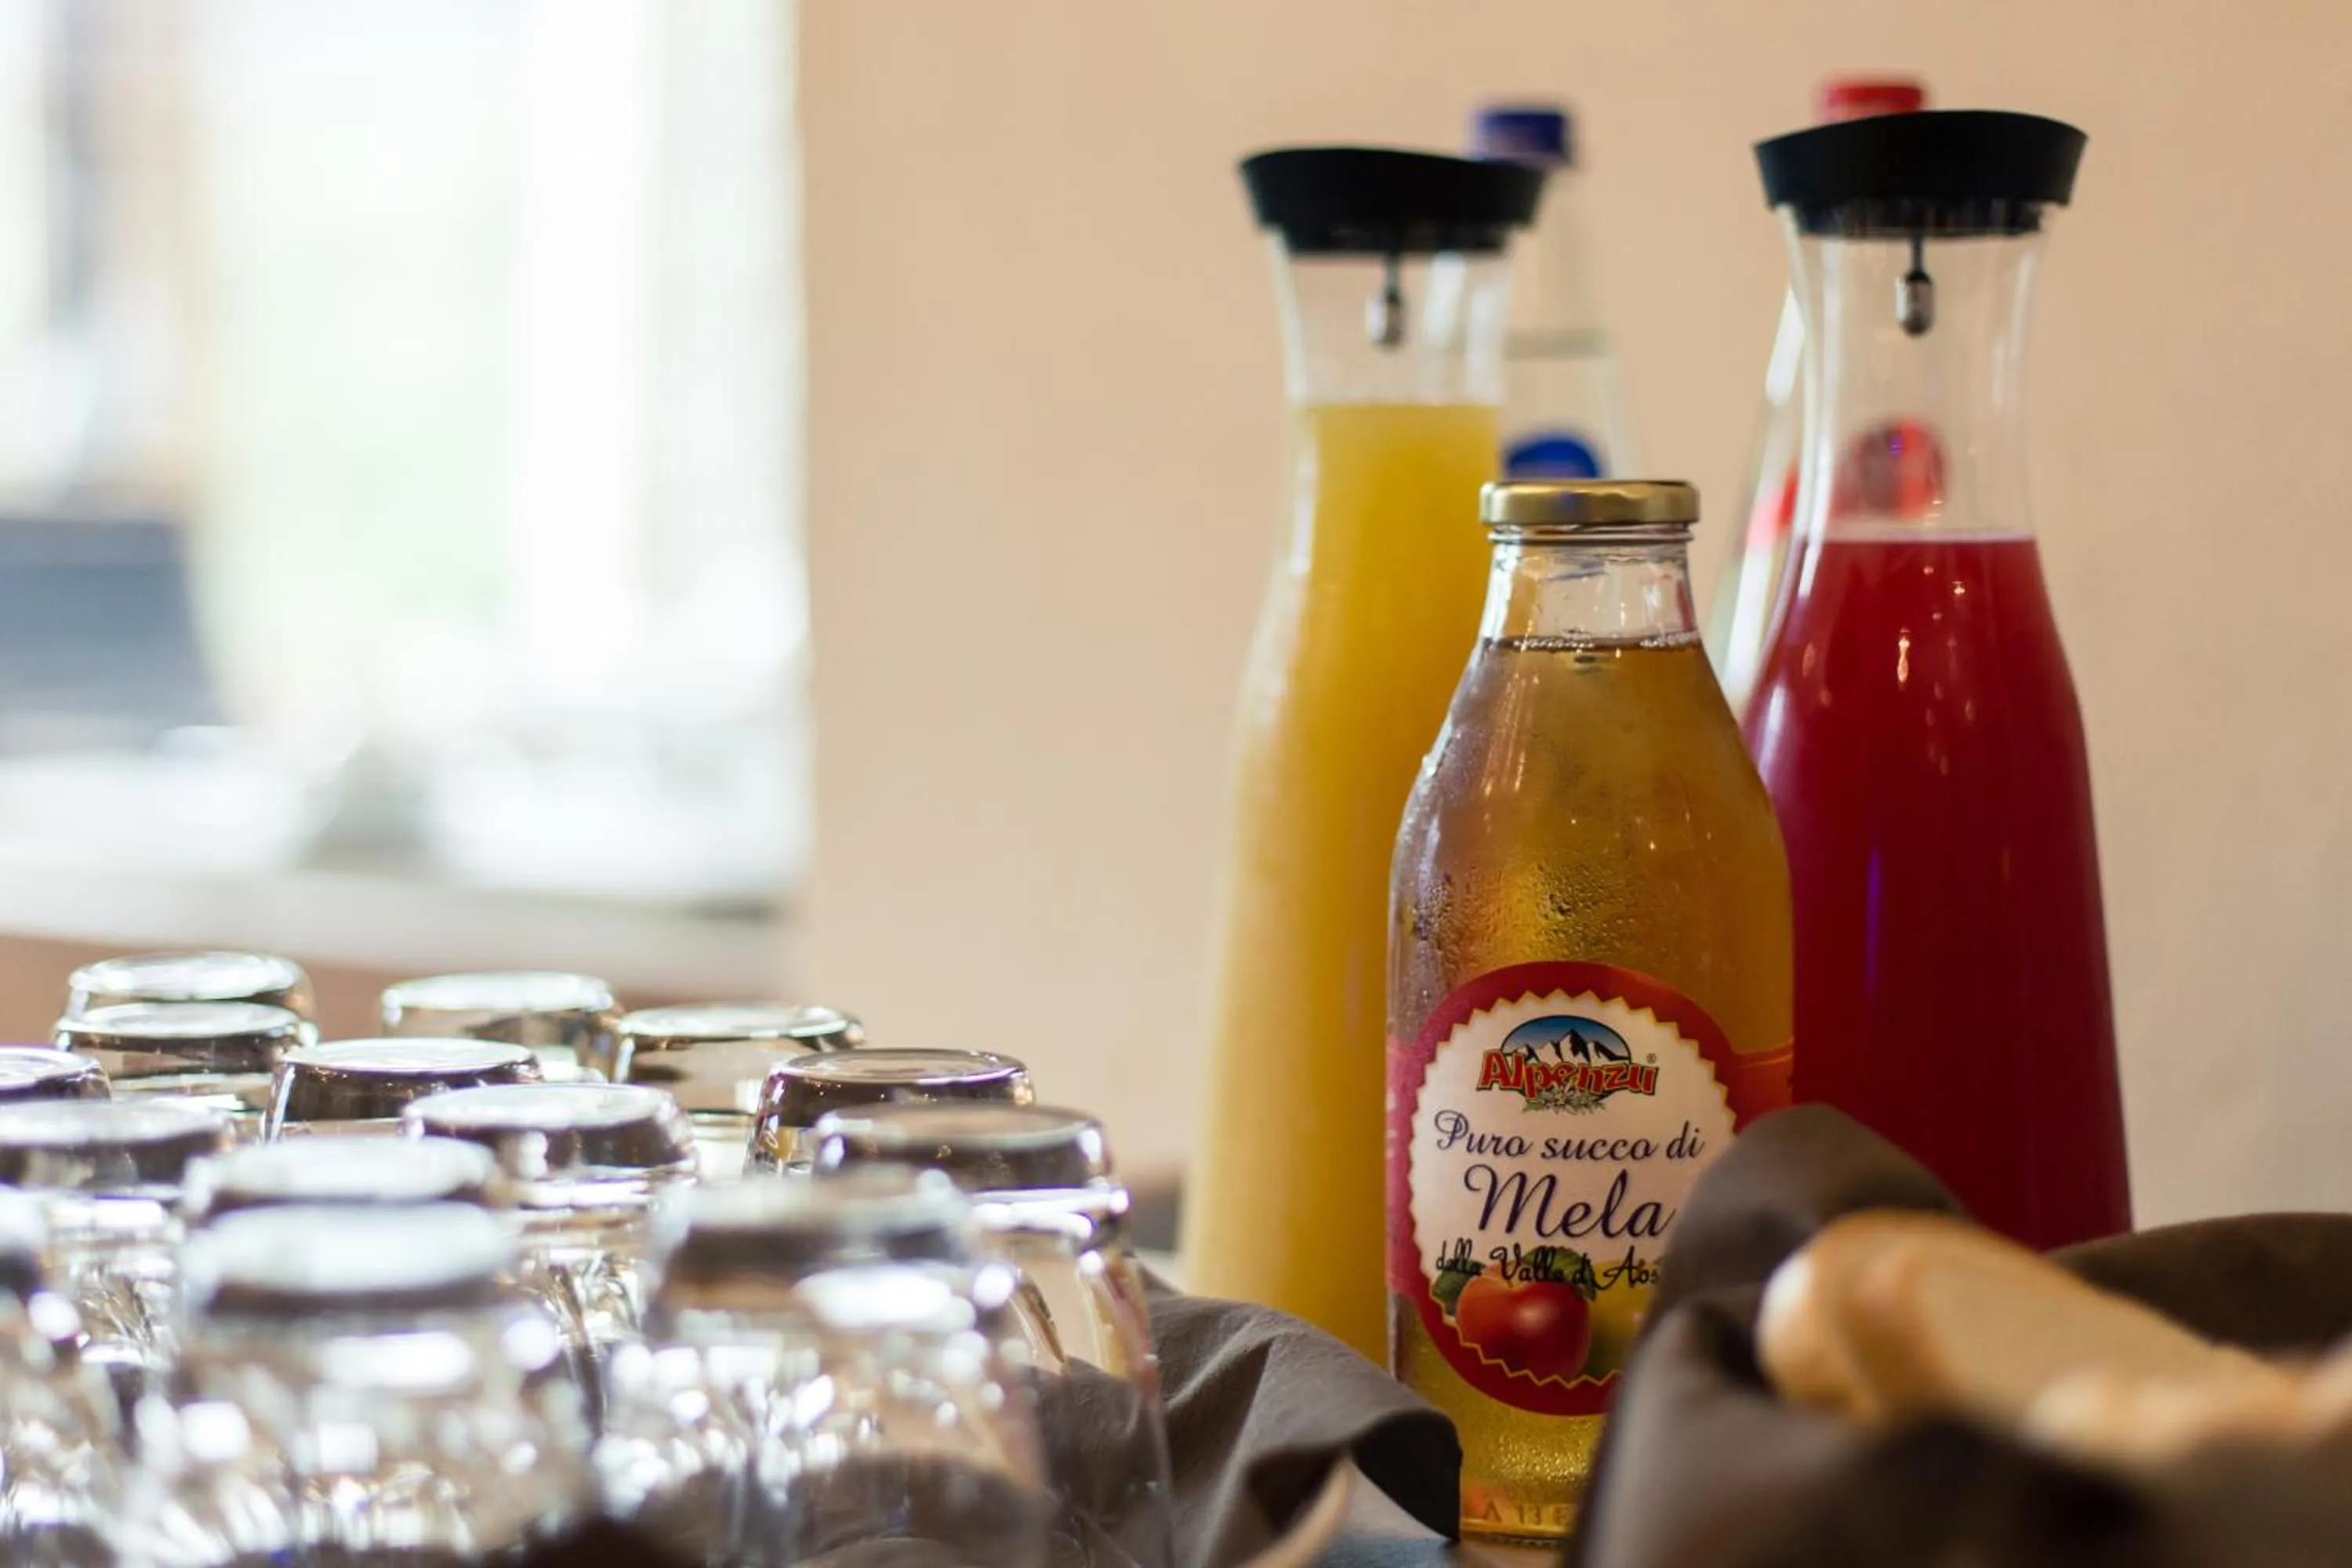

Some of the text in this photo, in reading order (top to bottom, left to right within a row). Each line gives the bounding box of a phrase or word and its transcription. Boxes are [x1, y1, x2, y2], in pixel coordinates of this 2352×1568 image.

[1476, 1048, 1660, 1102] Alpenzu
[1434, 1109, 1705, 1160] Puro succo di
[1463, 1164, 1676, 1240] Mela
[1490, 1243, 1566, 1288] Valle
